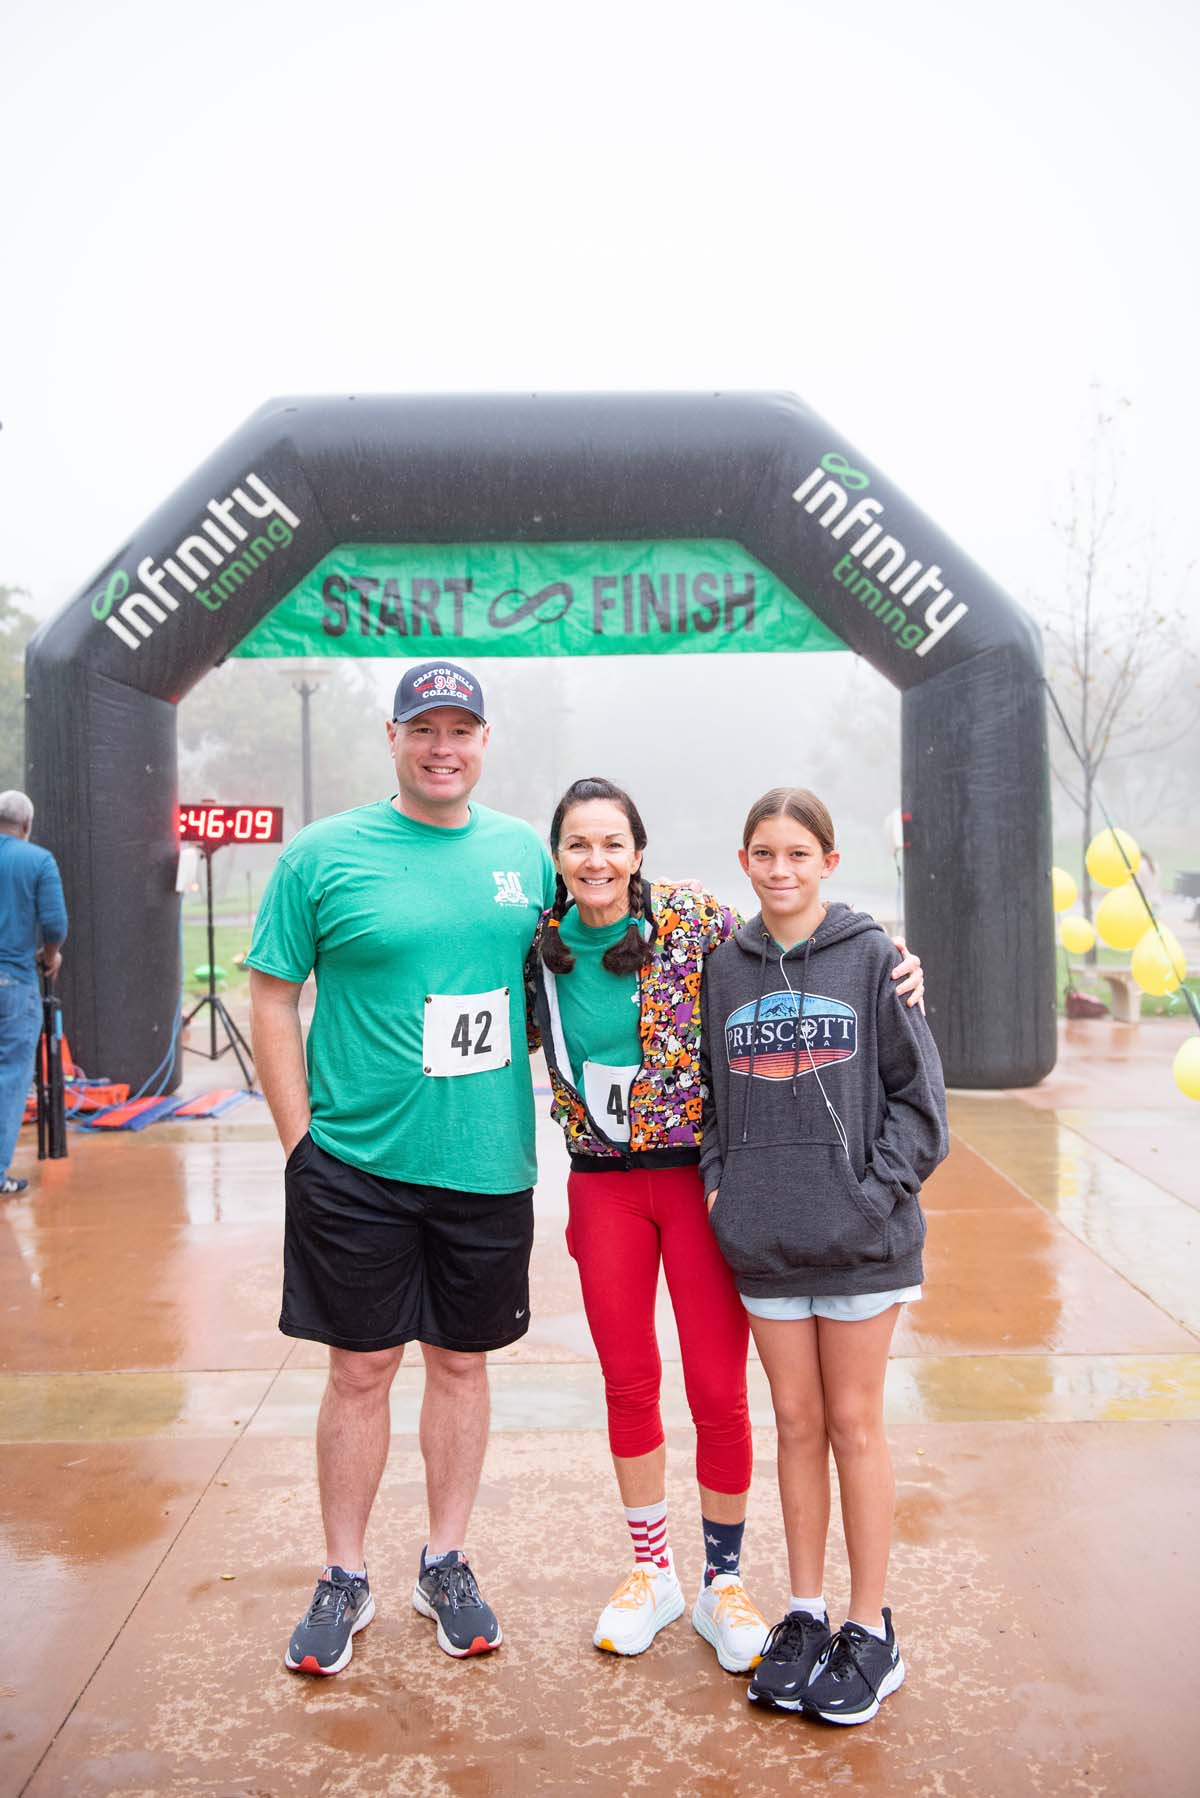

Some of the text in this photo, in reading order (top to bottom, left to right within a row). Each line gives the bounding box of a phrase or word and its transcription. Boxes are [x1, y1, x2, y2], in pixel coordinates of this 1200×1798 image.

[105, 472, 300, 650] infinity
[195, 518, 293, 611] timing
[792, 467, 969, 657] infinity
[321, 572, 756, 637] START FINISH
[832, 553, 926, 650] timing
[422, 689, 468, 701] COLLEGE
[434, 675, 457, 690] 95
[451, 1010, 492, 1057] 42
